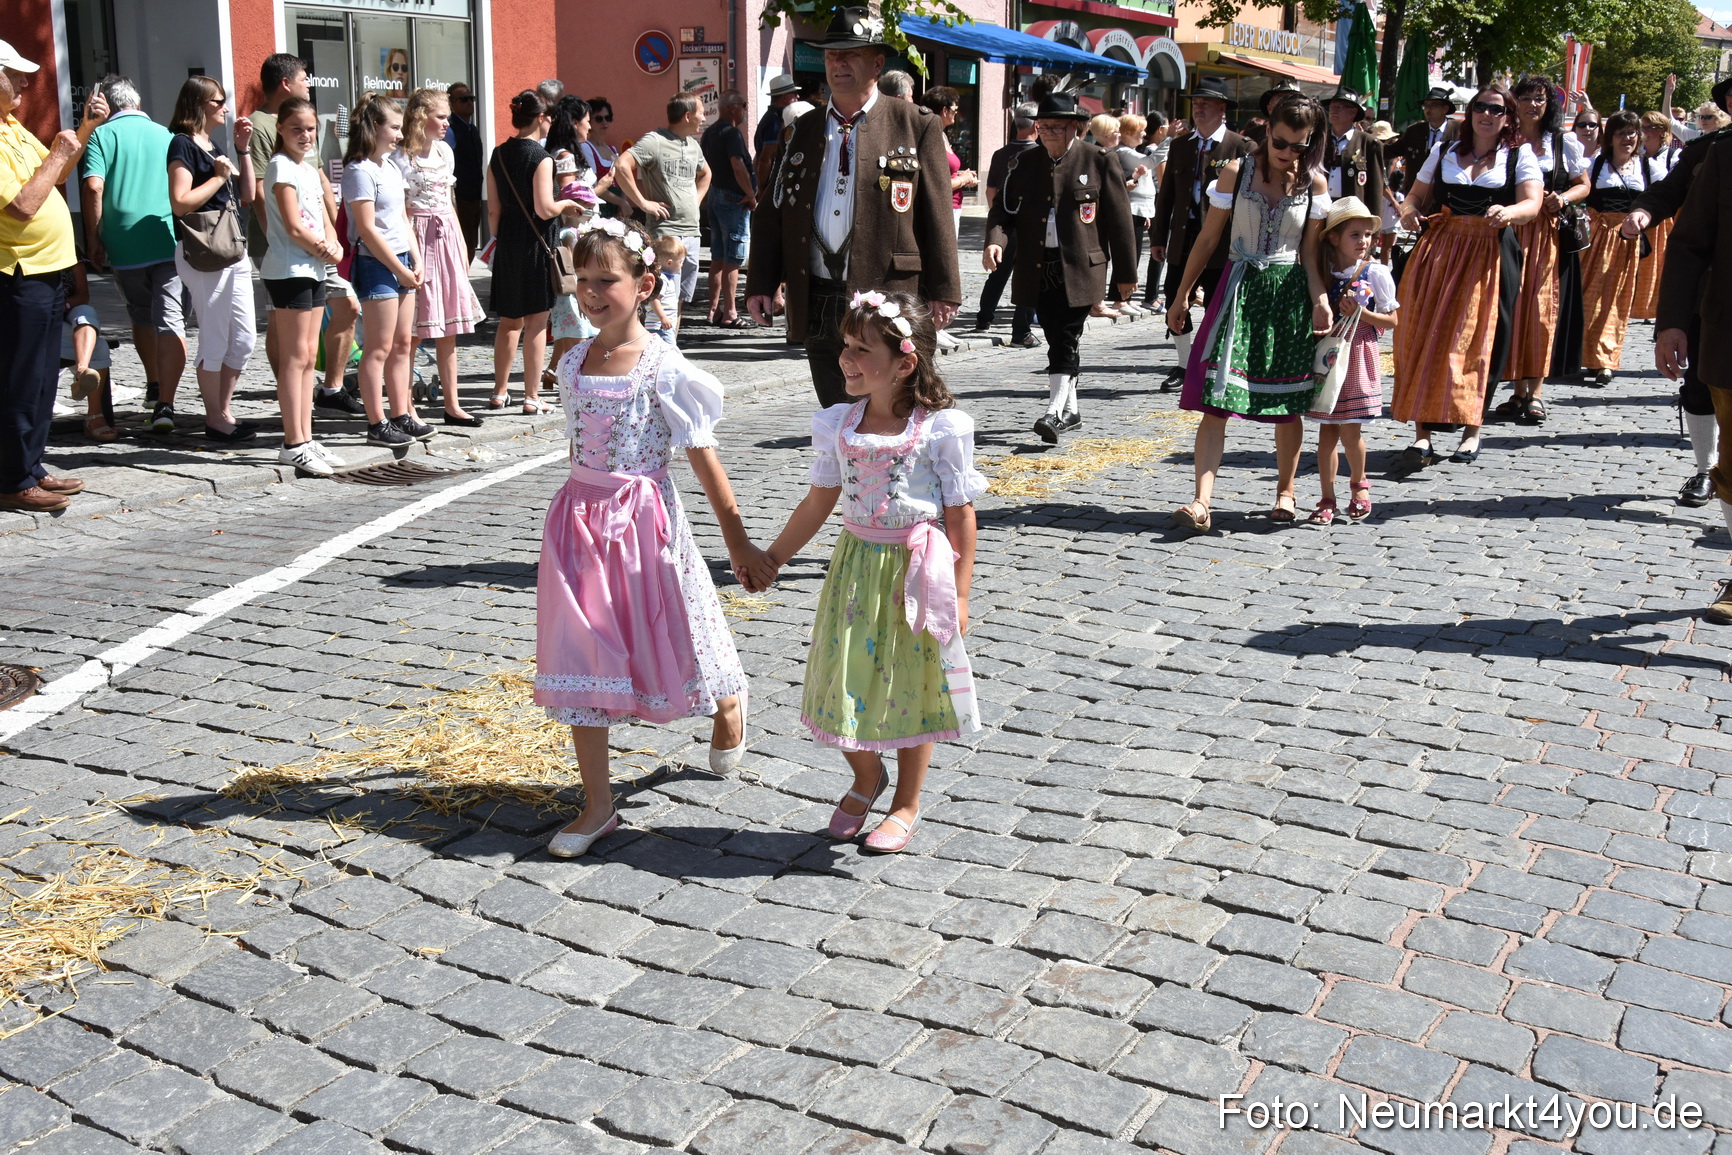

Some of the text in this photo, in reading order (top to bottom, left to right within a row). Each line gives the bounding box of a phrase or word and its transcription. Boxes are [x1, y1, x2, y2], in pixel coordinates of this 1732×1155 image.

[1229, 22, 1254, 48] LEDER
[682, 44, 724, 53] Bockwirtsgasse
[795, 51, 824, 65] Spirituose
[306, 74, 339, 88] elmann
[363, 75, 402, 90] fielmann
[425, 78, 451, 91] fielma
[664, 160, 677, 176] TRUE
